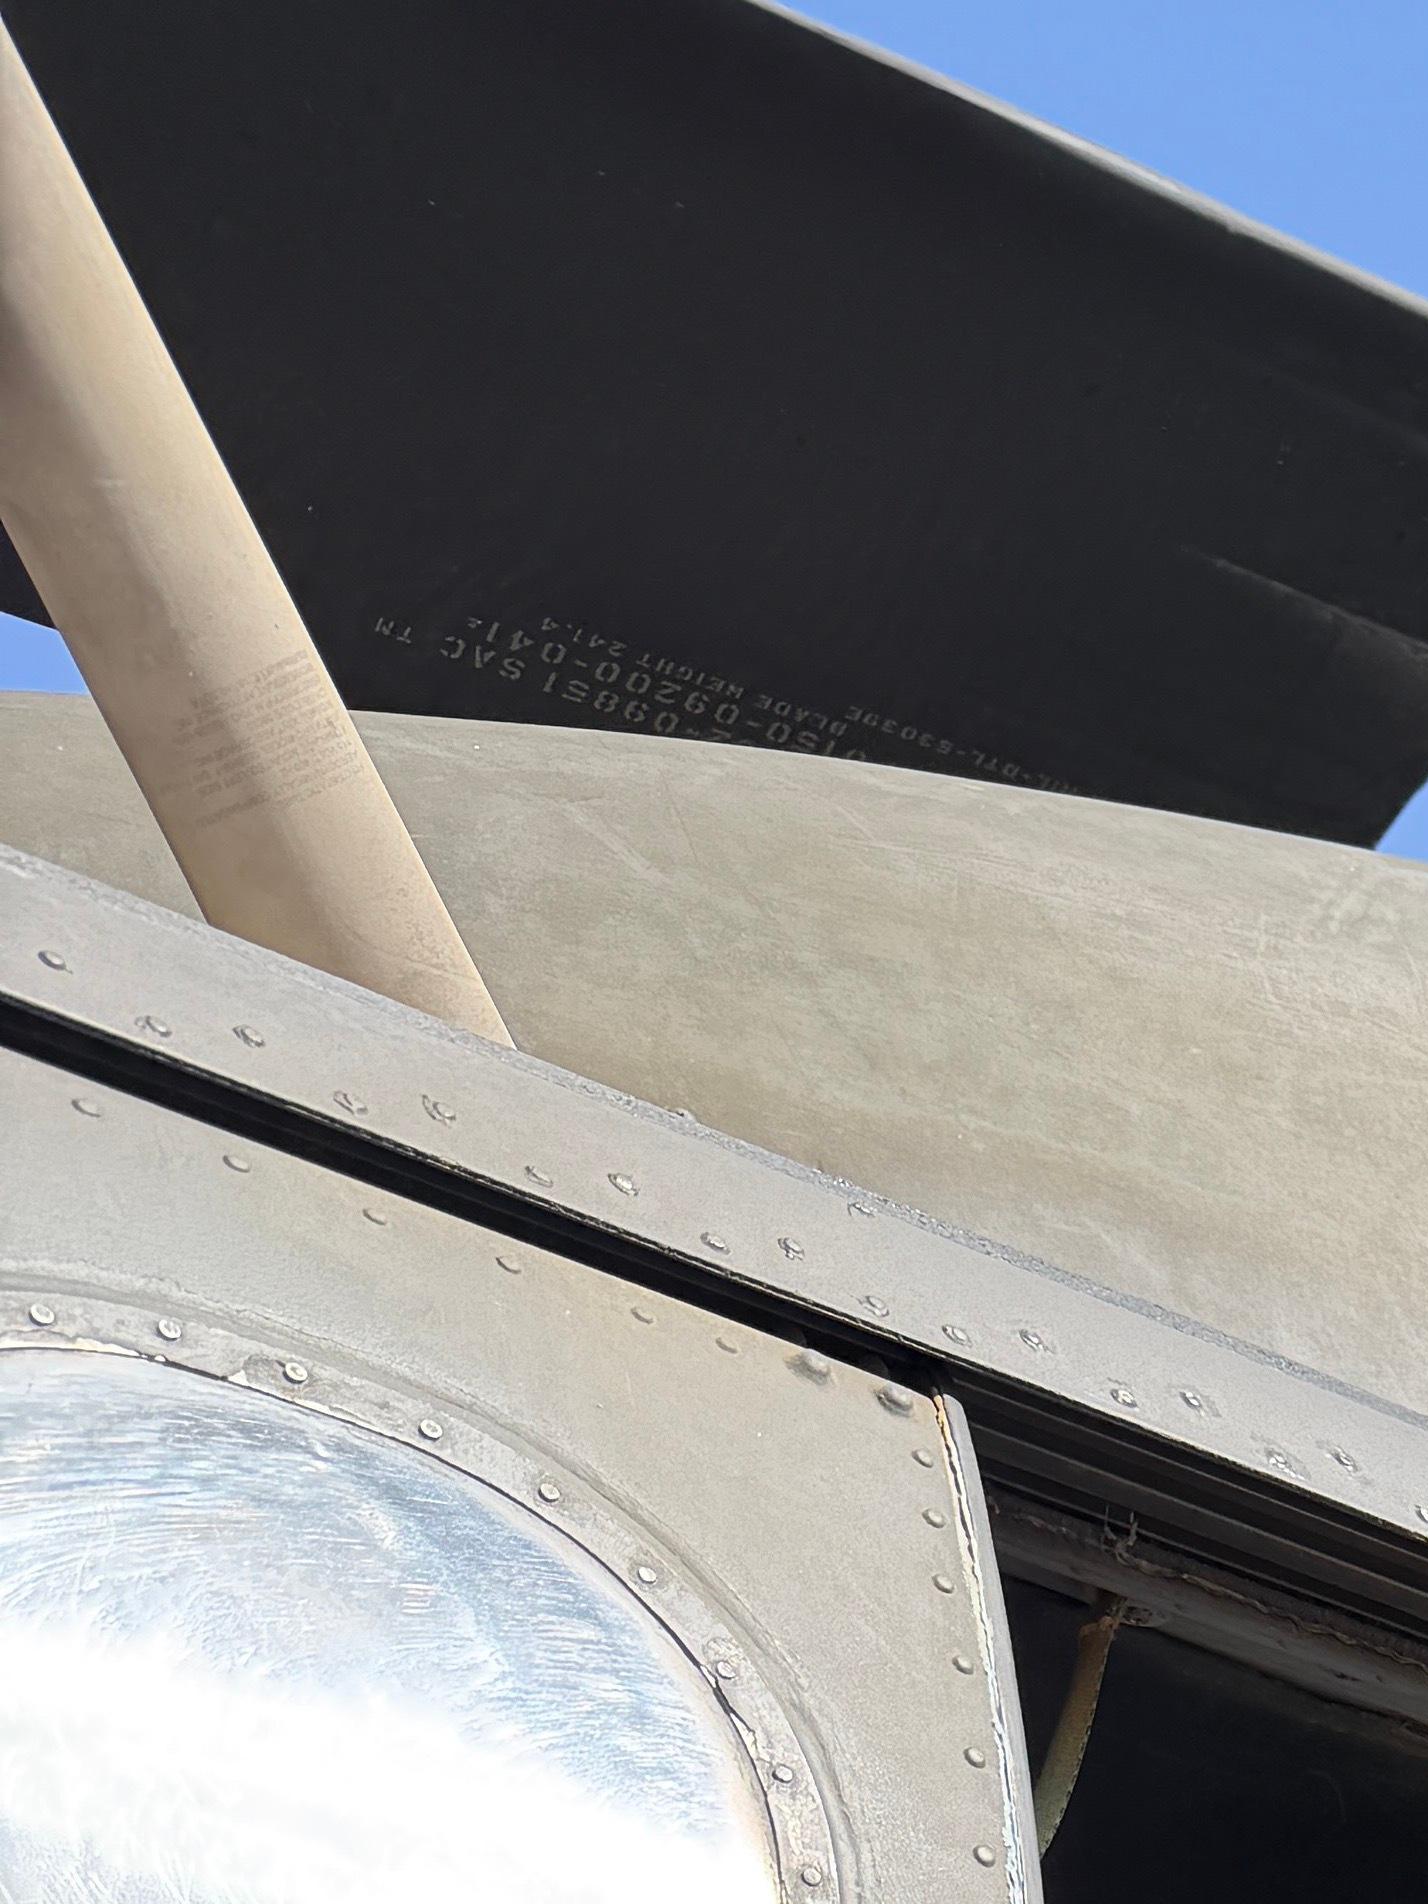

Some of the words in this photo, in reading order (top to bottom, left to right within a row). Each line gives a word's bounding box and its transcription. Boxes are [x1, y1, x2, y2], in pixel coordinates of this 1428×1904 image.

[440, 635, 526, 681] SAC
[541, 616, 629, 658] 241.4
[636, 653, 746, 700] WEIGHT
[756, 693, 848, 738] BLADE
